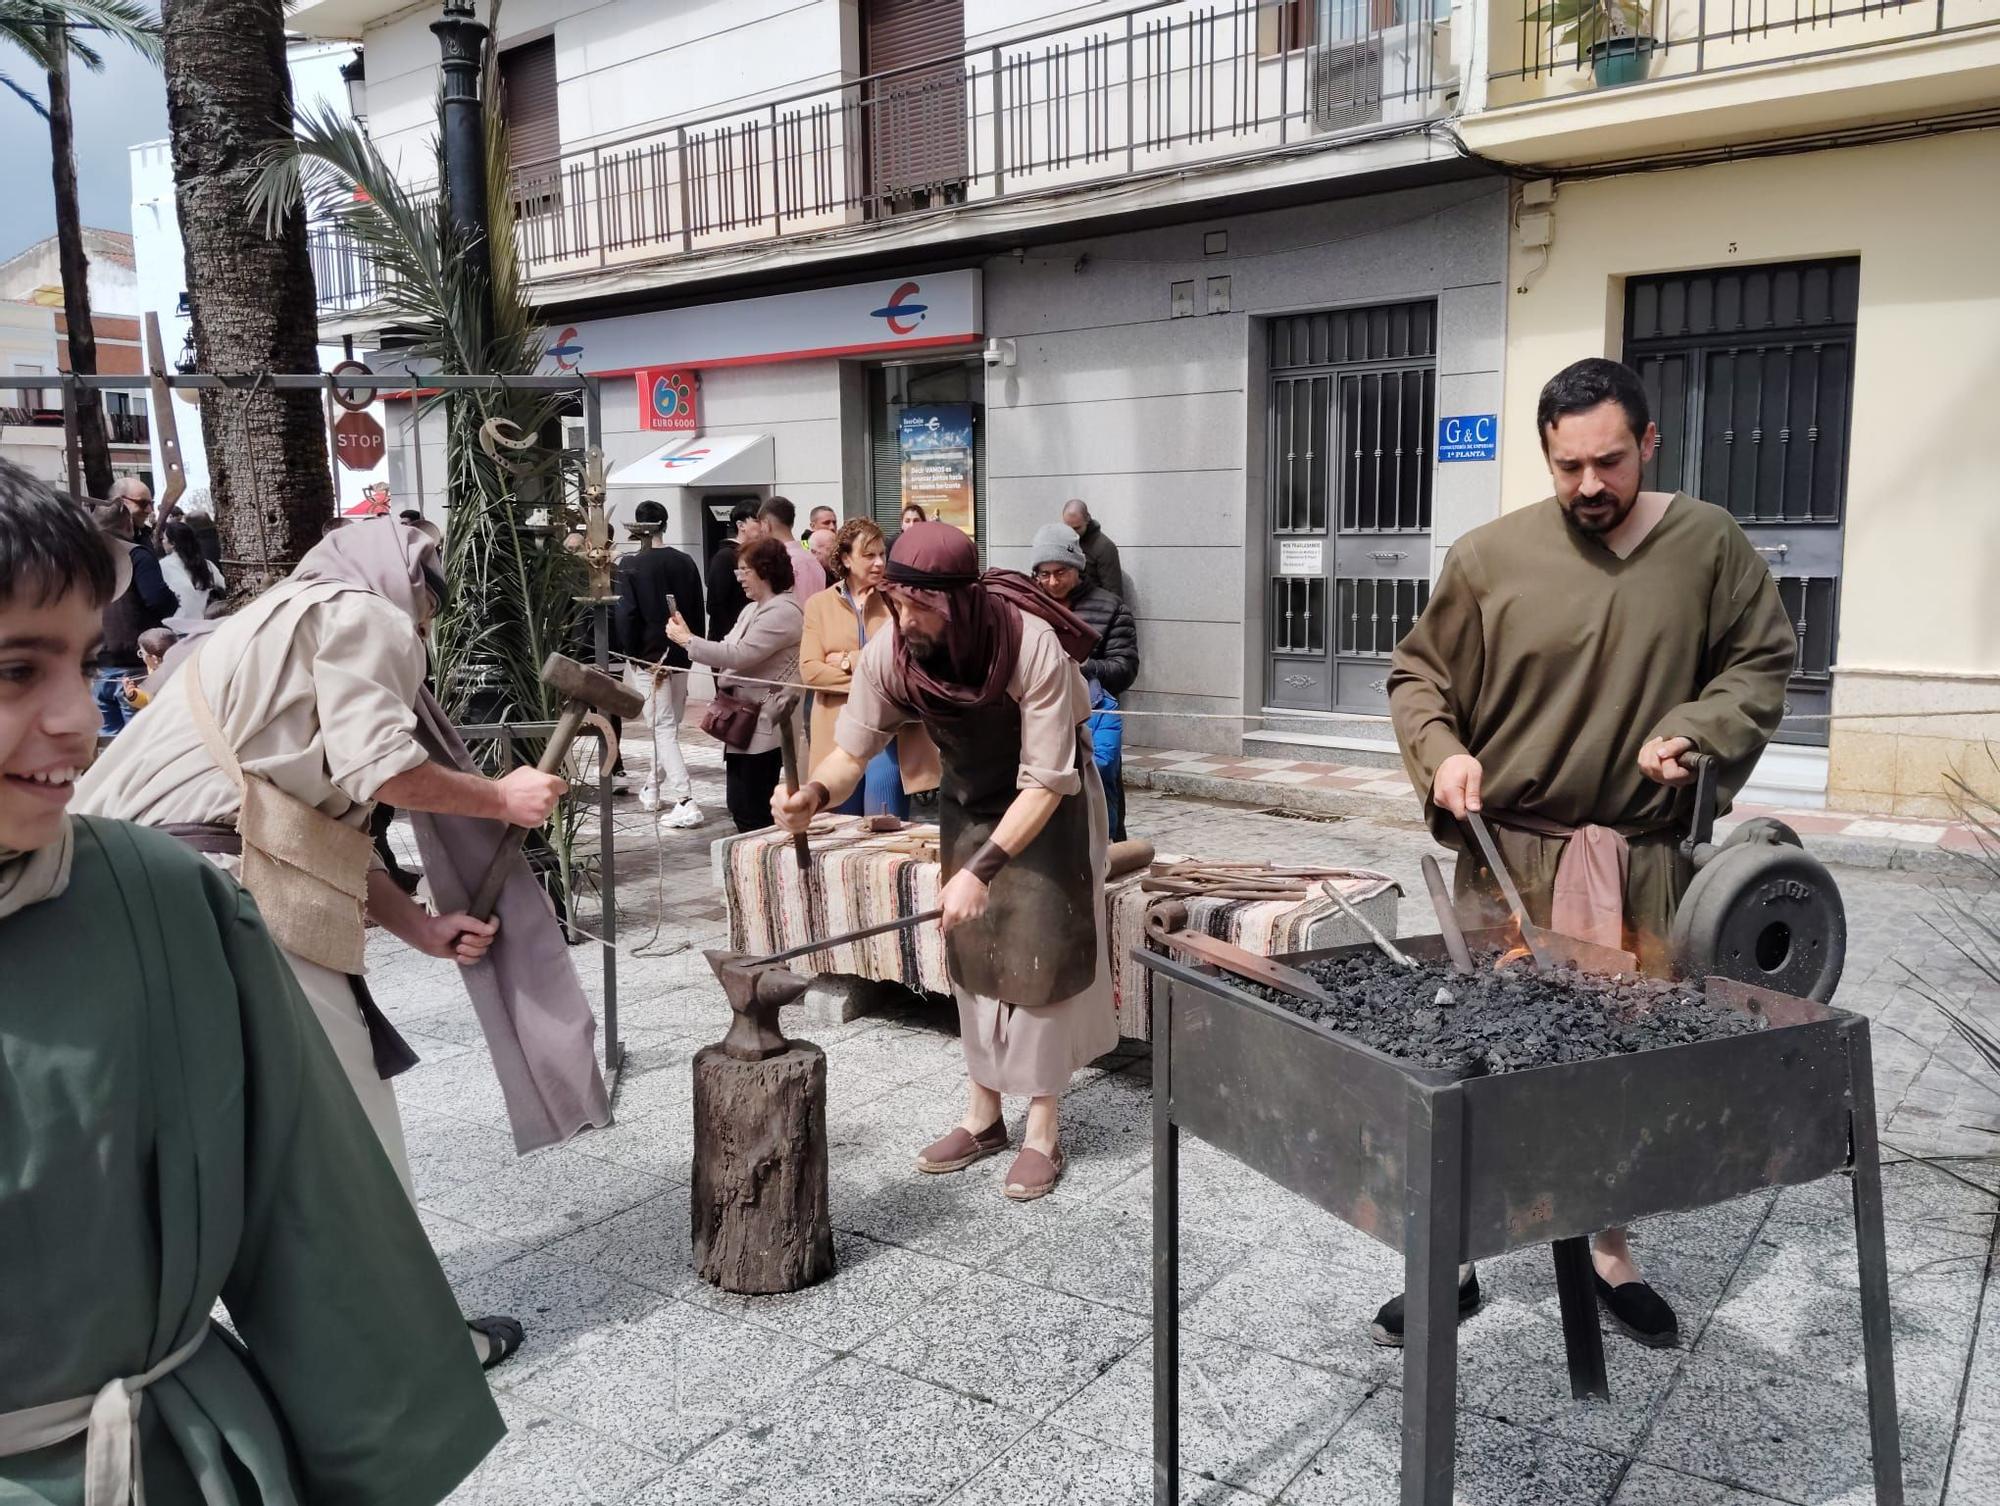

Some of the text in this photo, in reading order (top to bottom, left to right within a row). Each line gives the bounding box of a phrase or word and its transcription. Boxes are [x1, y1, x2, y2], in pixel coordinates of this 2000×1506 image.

[652, 418, 695, 427] EURO 6000
[1446, 418, 1489, 443] G & C
[337, 434, 381, 448] STOP
[1455, 450, 1486, 458] PLANTA
